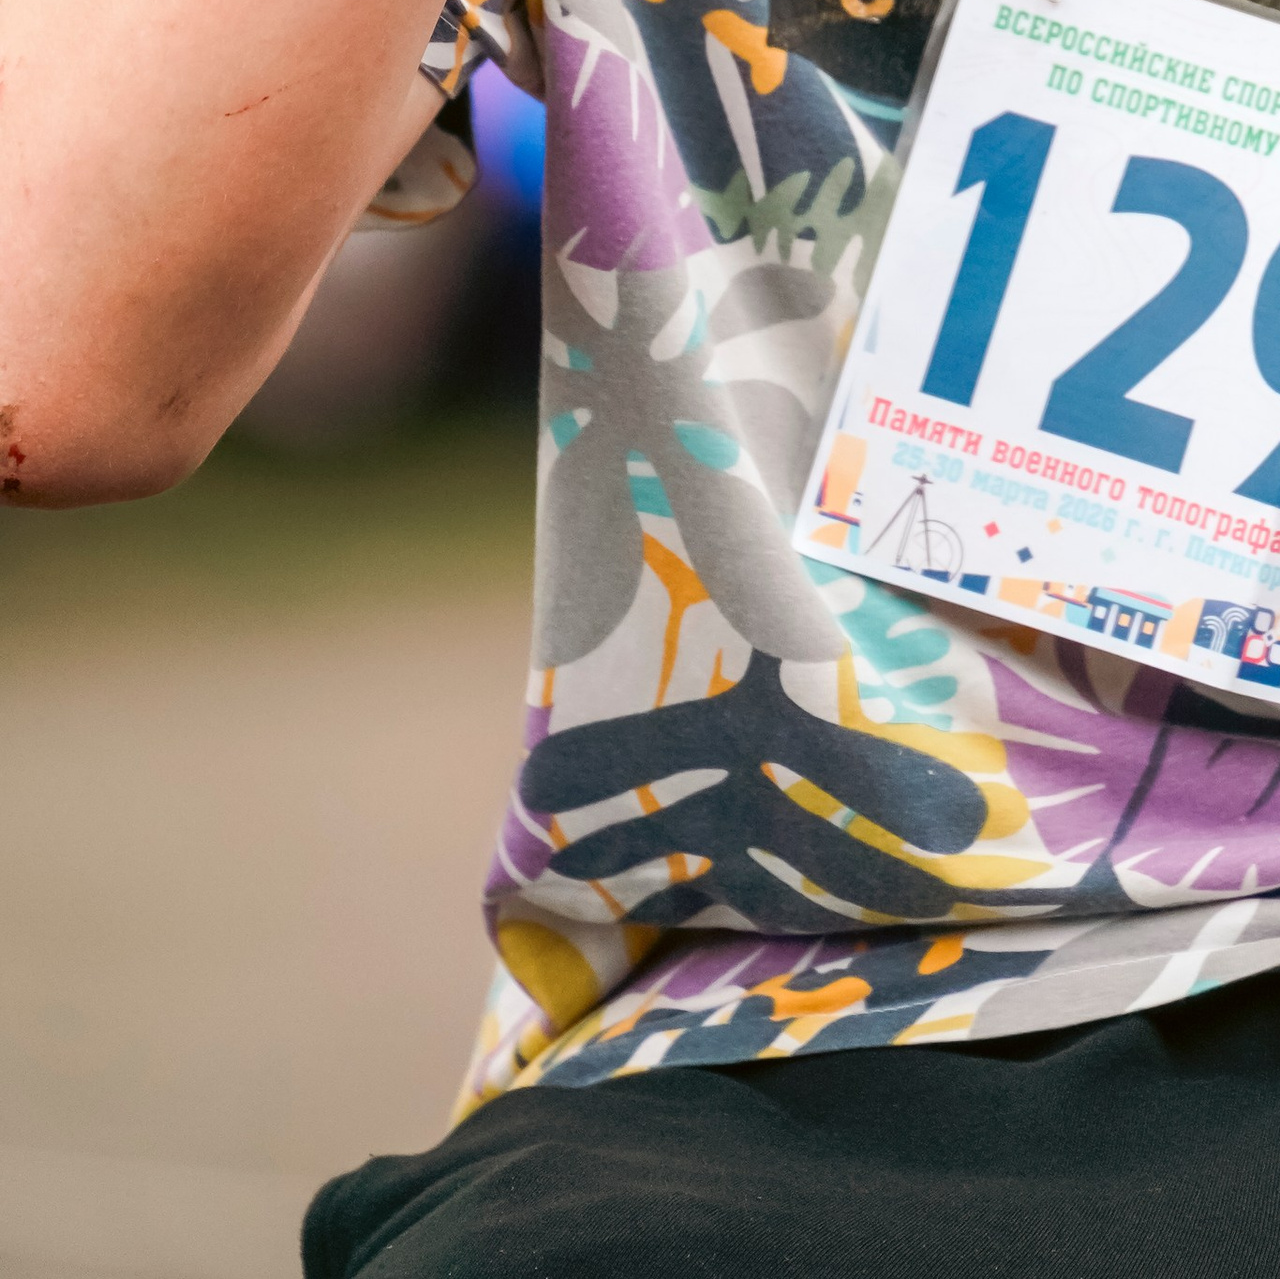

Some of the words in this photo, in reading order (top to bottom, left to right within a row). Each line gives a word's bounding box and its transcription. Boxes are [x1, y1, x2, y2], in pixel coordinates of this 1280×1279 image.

[993, 4, 1215, 94] ВСЕРОССИЙСКИЕ
[1046, 63, 1084, 96] ПО
[1091, 77, 1280, 157] СПОРТИВНОМУ
[868, 396, 983, 457] Памяти
[990, 439, 1126, 502] военного
[891, 441, 965, 484] 25-30
[969, 468, 1051, 512] марта
[1056, 492, 1119, 533] 2026
[1124, 517, 1144, 543] г.
[1154, 528, 1174, 554] г.
